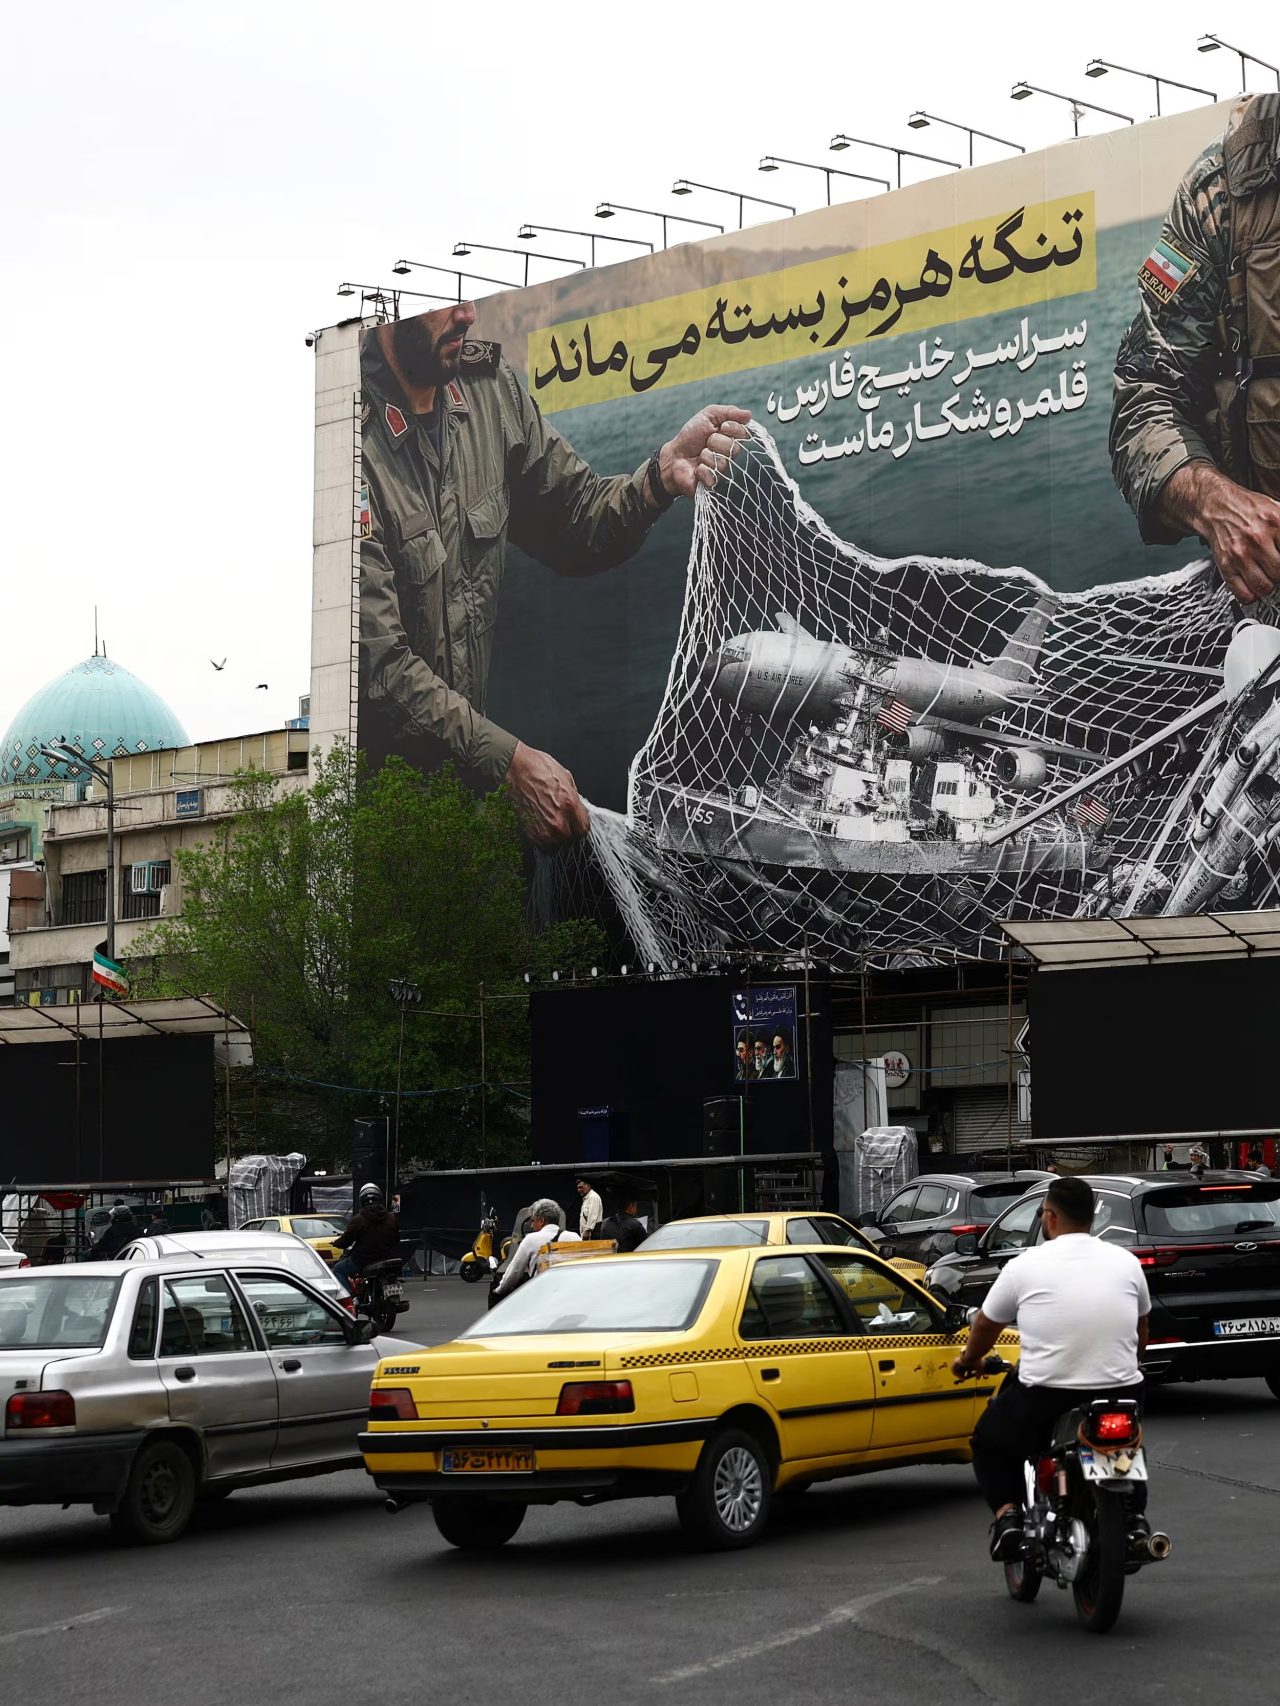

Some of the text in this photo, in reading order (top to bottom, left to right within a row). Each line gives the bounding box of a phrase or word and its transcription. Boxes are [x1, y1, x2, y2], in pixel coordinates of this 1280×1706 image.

[958, 206, 1084, 284] تنگه
[705, 290, 826, 345] بسته
[822, 248, 954, 348] هرمز
[1138, 267, 1172, 300] I.R.IRAN
[856, 336, 955, 411] خلیج
[952, 317, 1088, 386] سراسر
[798, 359, 1089, 465] قلمرو شکار ماست
[687, 805, 715, 825] USS
